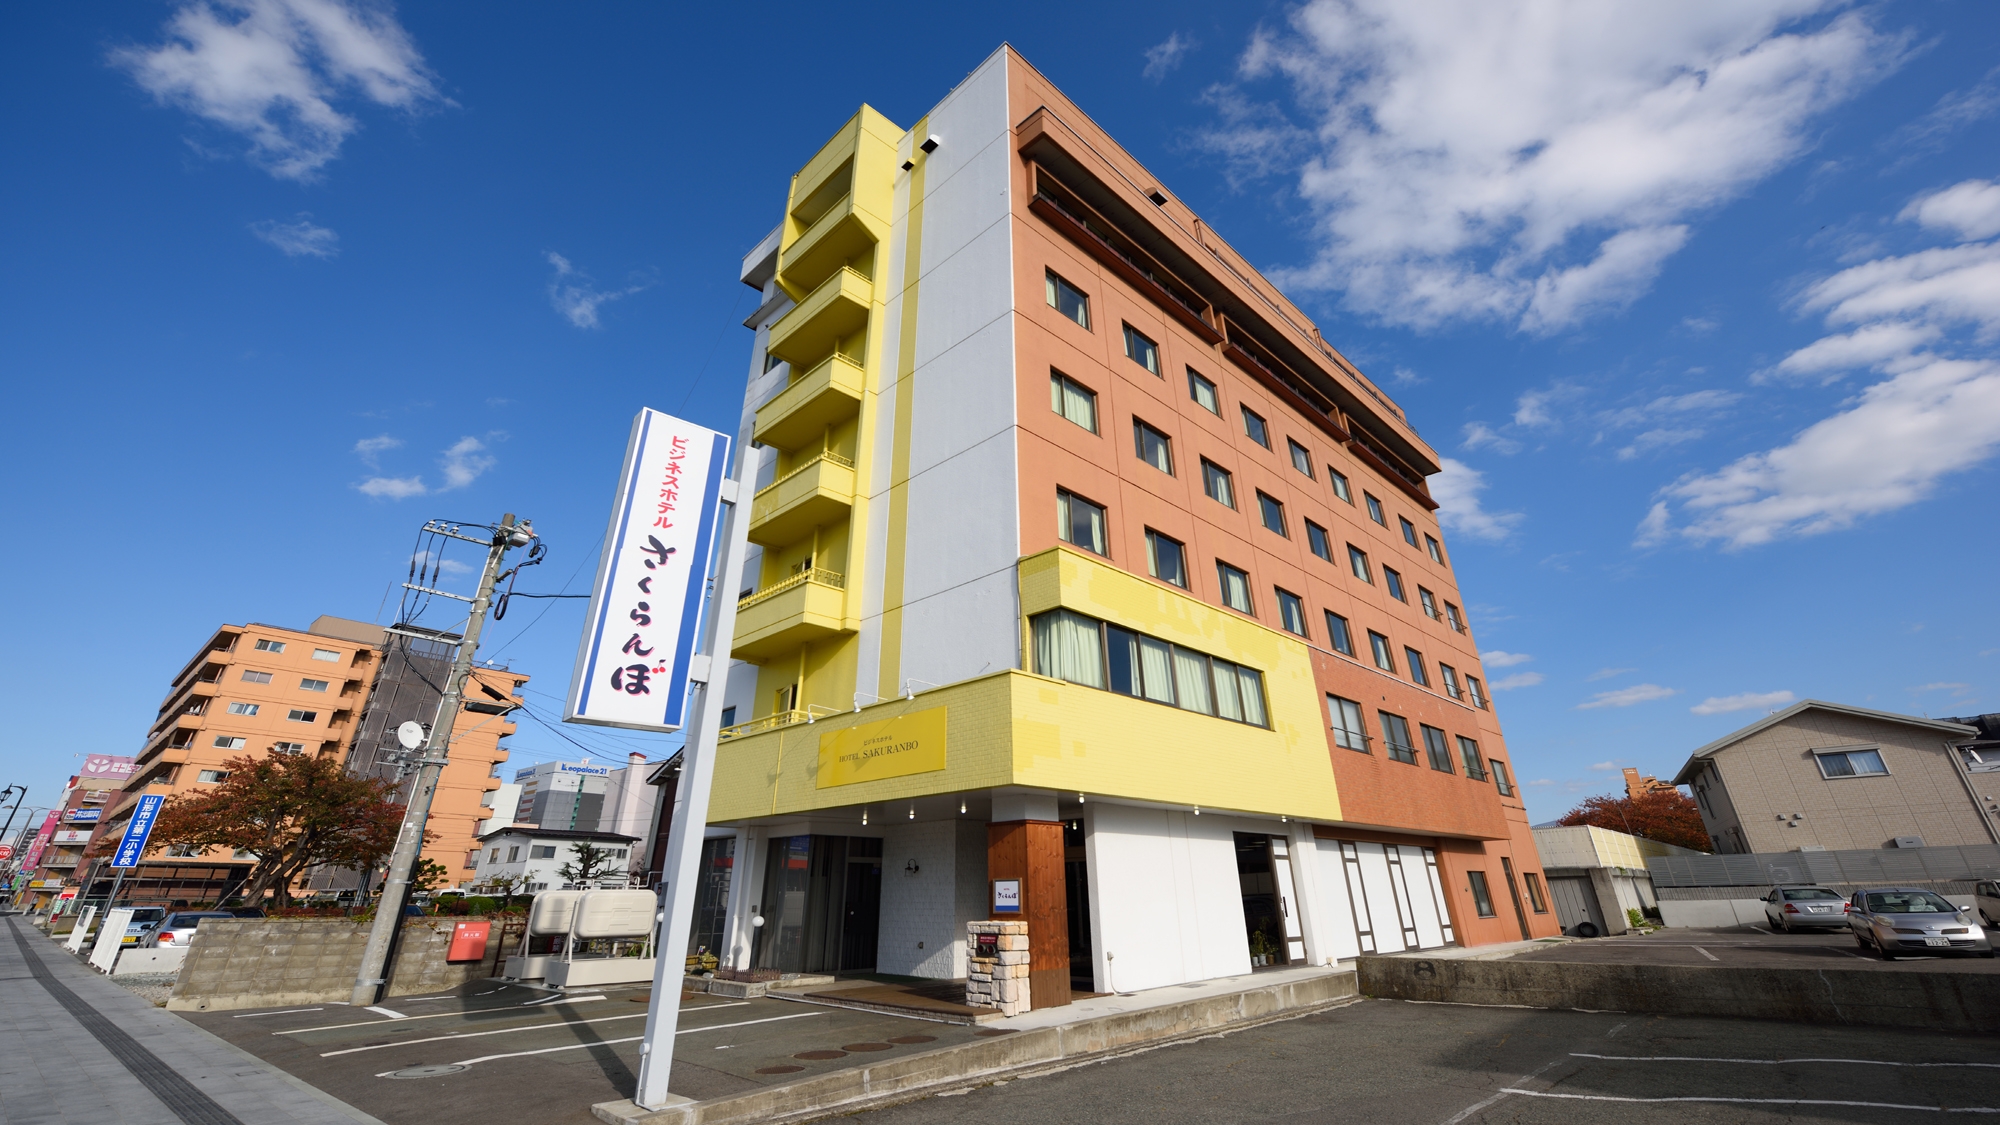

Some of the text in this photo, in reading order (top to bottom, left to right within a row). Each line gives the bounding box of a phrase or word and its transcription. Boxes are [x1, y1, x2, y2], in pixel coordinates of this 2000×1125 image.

[653, 435, 690, 529] ビジネスホテル
[610, 534, 677, 696] さくらんぼ
[838, 740, 919, 763] HOTEL SAKURANBO
[863, 735, 893, 746] ビジネスホテル
[119, 797, 158, 866] 山形市立第二小学校
[1413, 960, 1437, 980] 8
